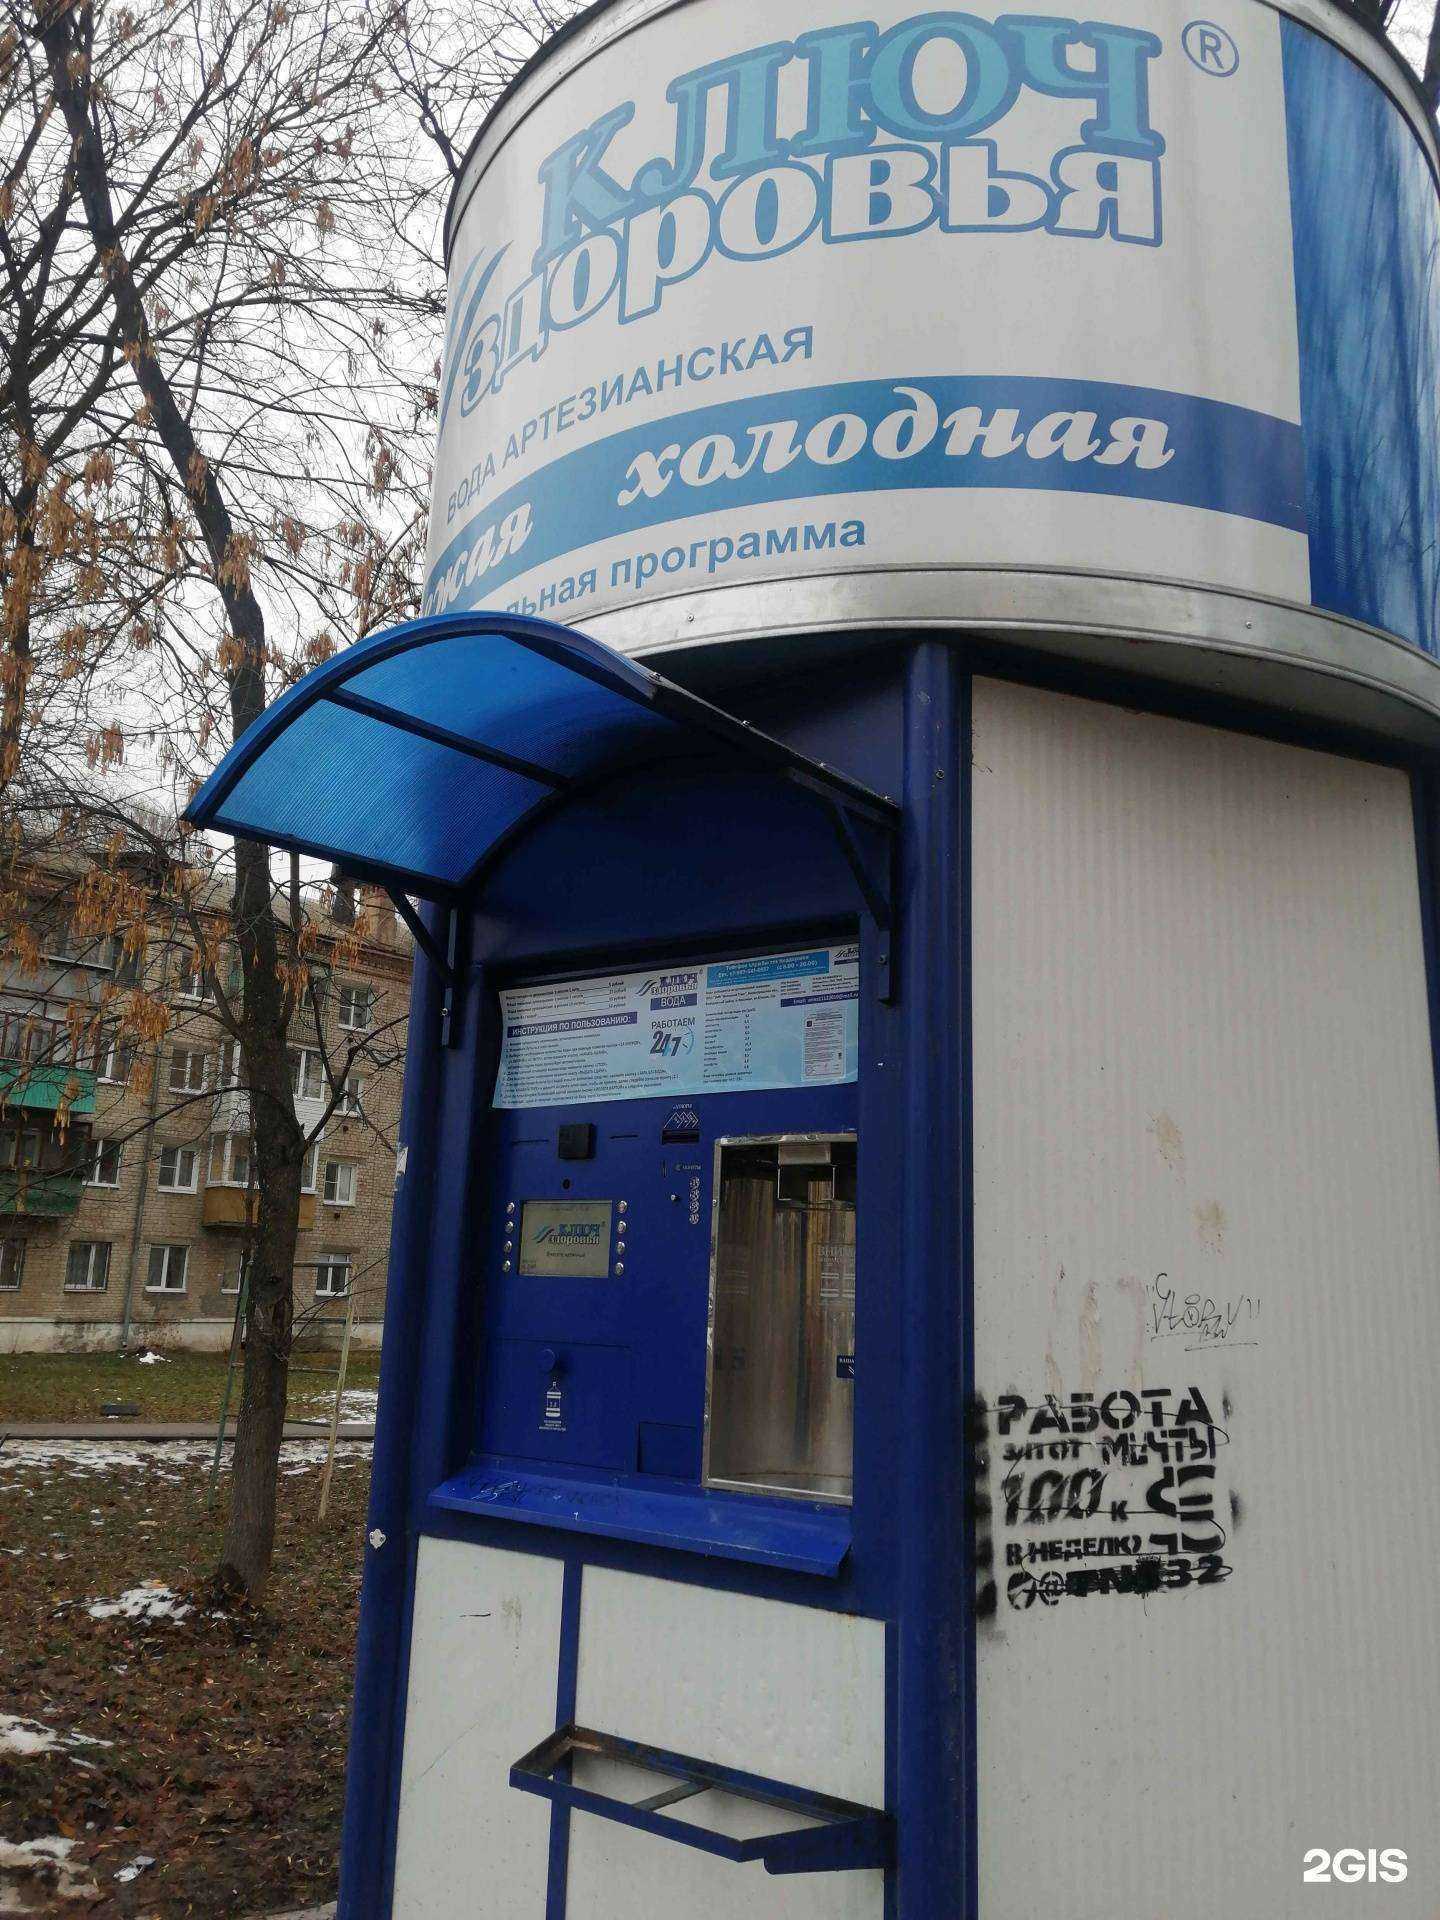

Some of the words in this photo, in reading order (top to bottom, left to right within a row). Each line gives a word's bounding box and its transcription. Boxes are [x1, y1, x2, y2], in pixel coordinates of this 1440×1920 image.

[447, 452, 496, 525] ВОДА
[502, 325, 814, 469] АРТЕЗИАНСКАЯ
[617, 386, 1174, 506] холодная
[611, 519, 866, 588] программа
[651, 1016, 696, 1030] РАБОТАЕМ
[661, 995, 686, 1008] ВОДА
[512, 1022, 558, 1037] ИНСТРУКЦИЯ
[560, 1020, 570, 1031] ПО
[998, 1387, 1214, 1435] РАБОТА
